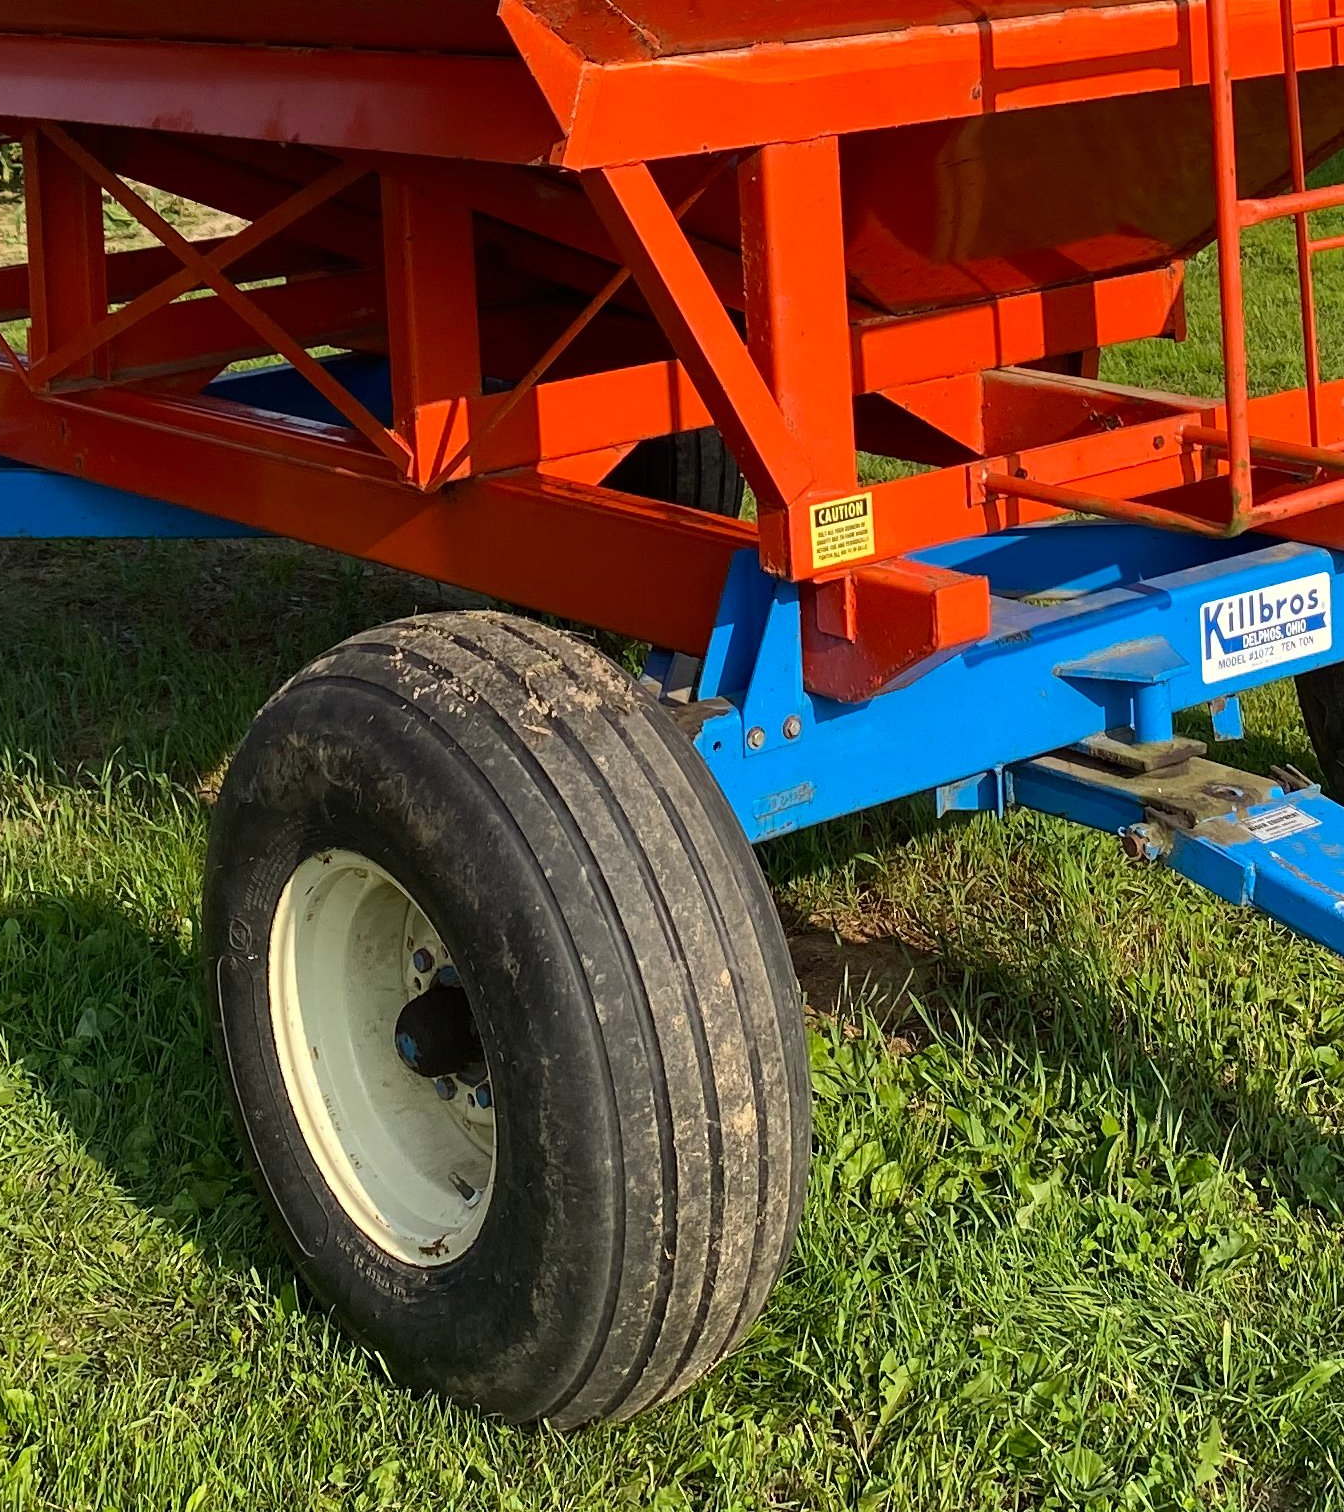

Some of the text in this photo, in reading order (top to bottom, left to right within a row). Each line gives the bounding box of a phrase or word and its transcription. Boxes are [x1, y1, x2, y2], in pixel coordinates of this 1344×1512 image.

[818, 500, 864, 525] CAUTION
[1242, 619, 1307, 649] DELPHOS, OHIO
[1218, 653, 1246, 669] MODEL
[1248, 645, 1274, 661] #1072
[1281, 640, 1296, 652] TEN
[1299, 635, 1314, 647] TON
